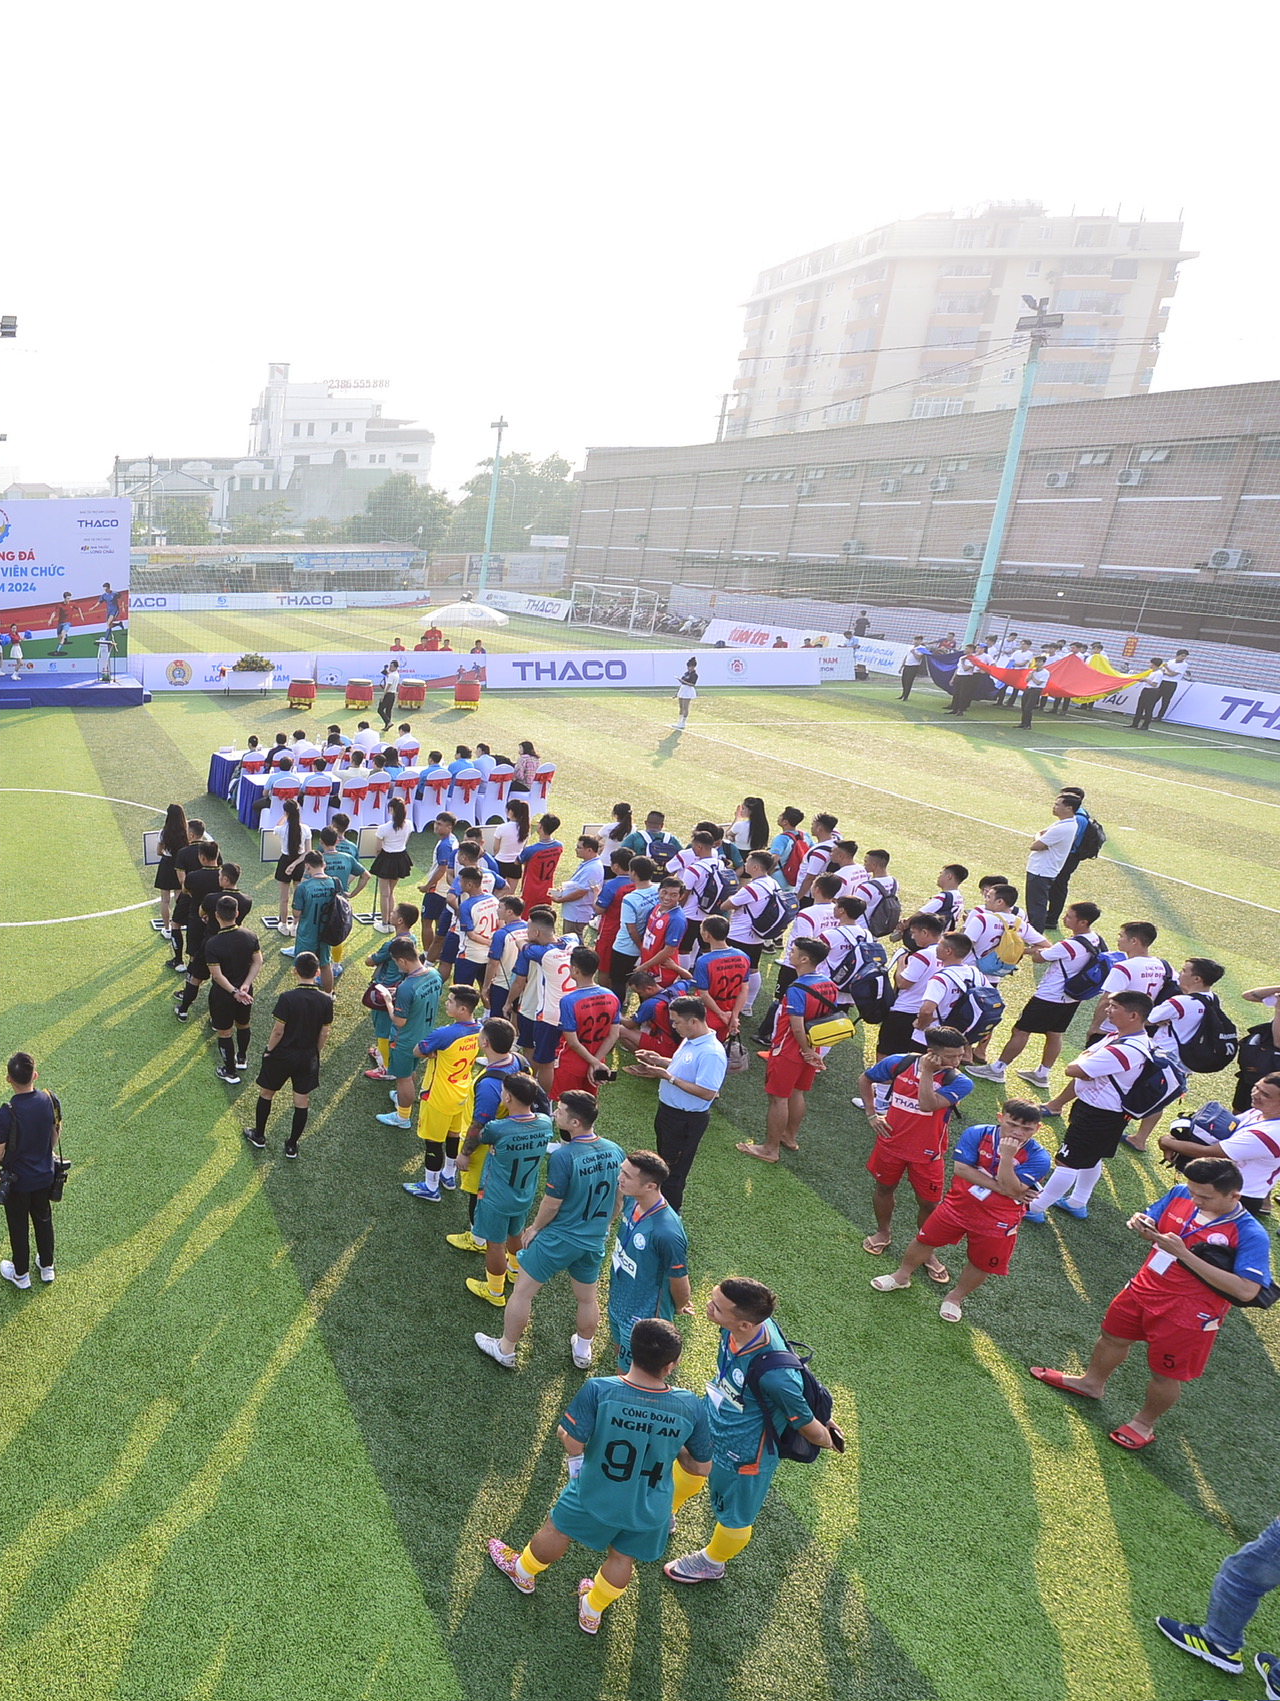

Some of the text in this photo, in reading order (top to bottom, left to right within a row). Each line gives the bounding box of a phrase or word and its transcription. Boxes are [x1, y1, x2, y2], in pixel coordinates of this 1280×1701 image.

[77, 519, 119, 527] THACO
[18, 548, 35, 560] ĐÁ
[0, 565, 28, 577] VIÊN
[31, 564, 65, 577] CHỨC
[7, 582, 36, 592] 2024
[276, 596, 333, 605] THACO
[526, 599, 561, 614] THACO
[512, 660, 627, 681] THACO
[1219, 696, 1280, 731] TH
[539, 860, 556, 880] 12
[715, 974, 743, 1001] 22
[425, 1001, 434, 1027] 4
[579, 1012, 610, 1044] 22
[894, 1097, 920, 1110] THAC
[512, 1132, 545, 1142] CÔNG ĐOÀN
[507, 1140, 548, 1151] NGHỆ AN
[582, 1152, 613, 1165] CÔNG ĐOÀN
[508, 1155, 540, 1189] 17
[579, 1161, 619, 1177] NGHỆ AN
[929, 1182, 937, 1193] 4
[582, 1181, 612, 1221] 12
[988, 1256, 999, 1268] 9
[1163, 1353, 1176, 1369] 5
[622, 1406, 675, 1424] CÔNG ĐOÀN
[610, 1416, 681, 1438] NGHỆ AN
[601, 1439, 663, 1489] 94
